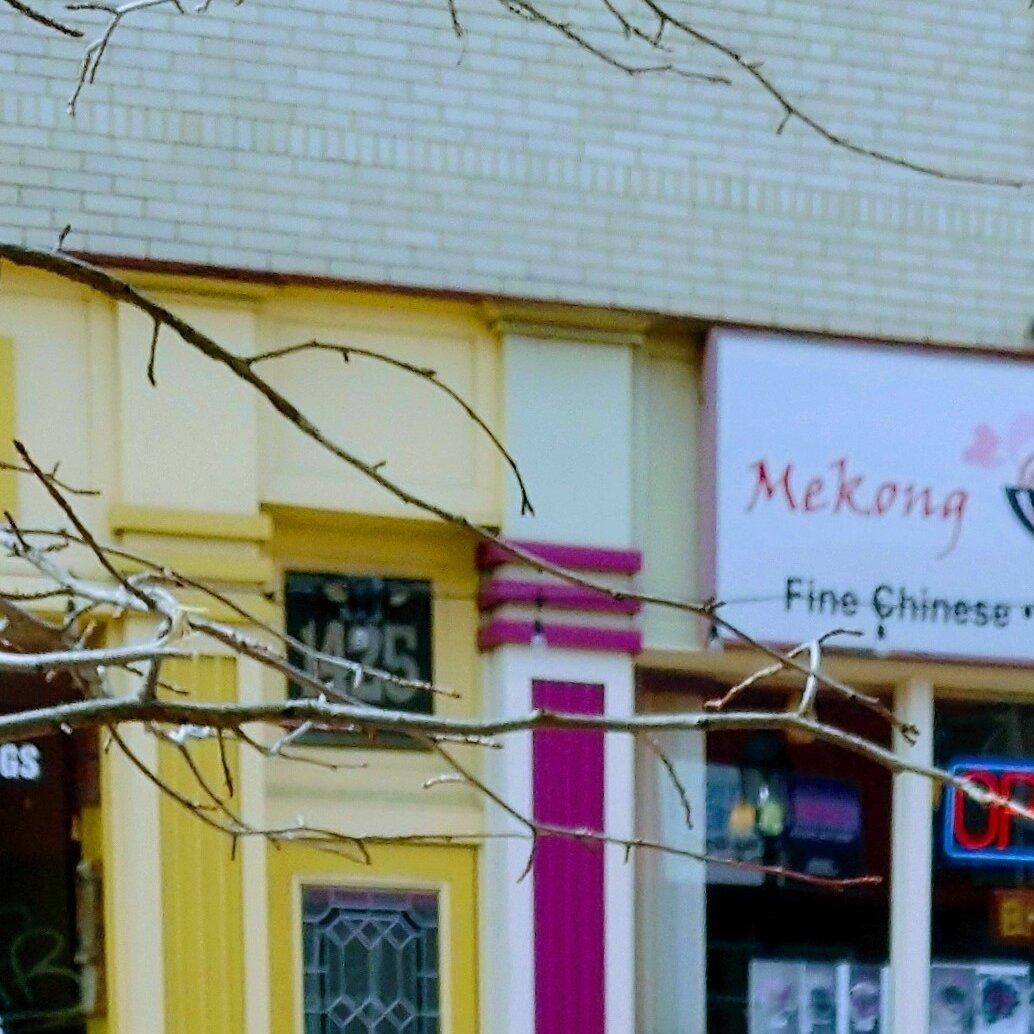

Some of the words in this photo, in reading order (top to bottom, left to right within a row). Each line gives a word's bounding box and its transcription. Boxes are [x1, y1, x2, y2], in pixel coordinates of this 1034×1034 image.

[746, 457, 969, 559] Mekong
[785, 575, 859, 618] Fine
[871, 583, 1011, 628] Chinese
